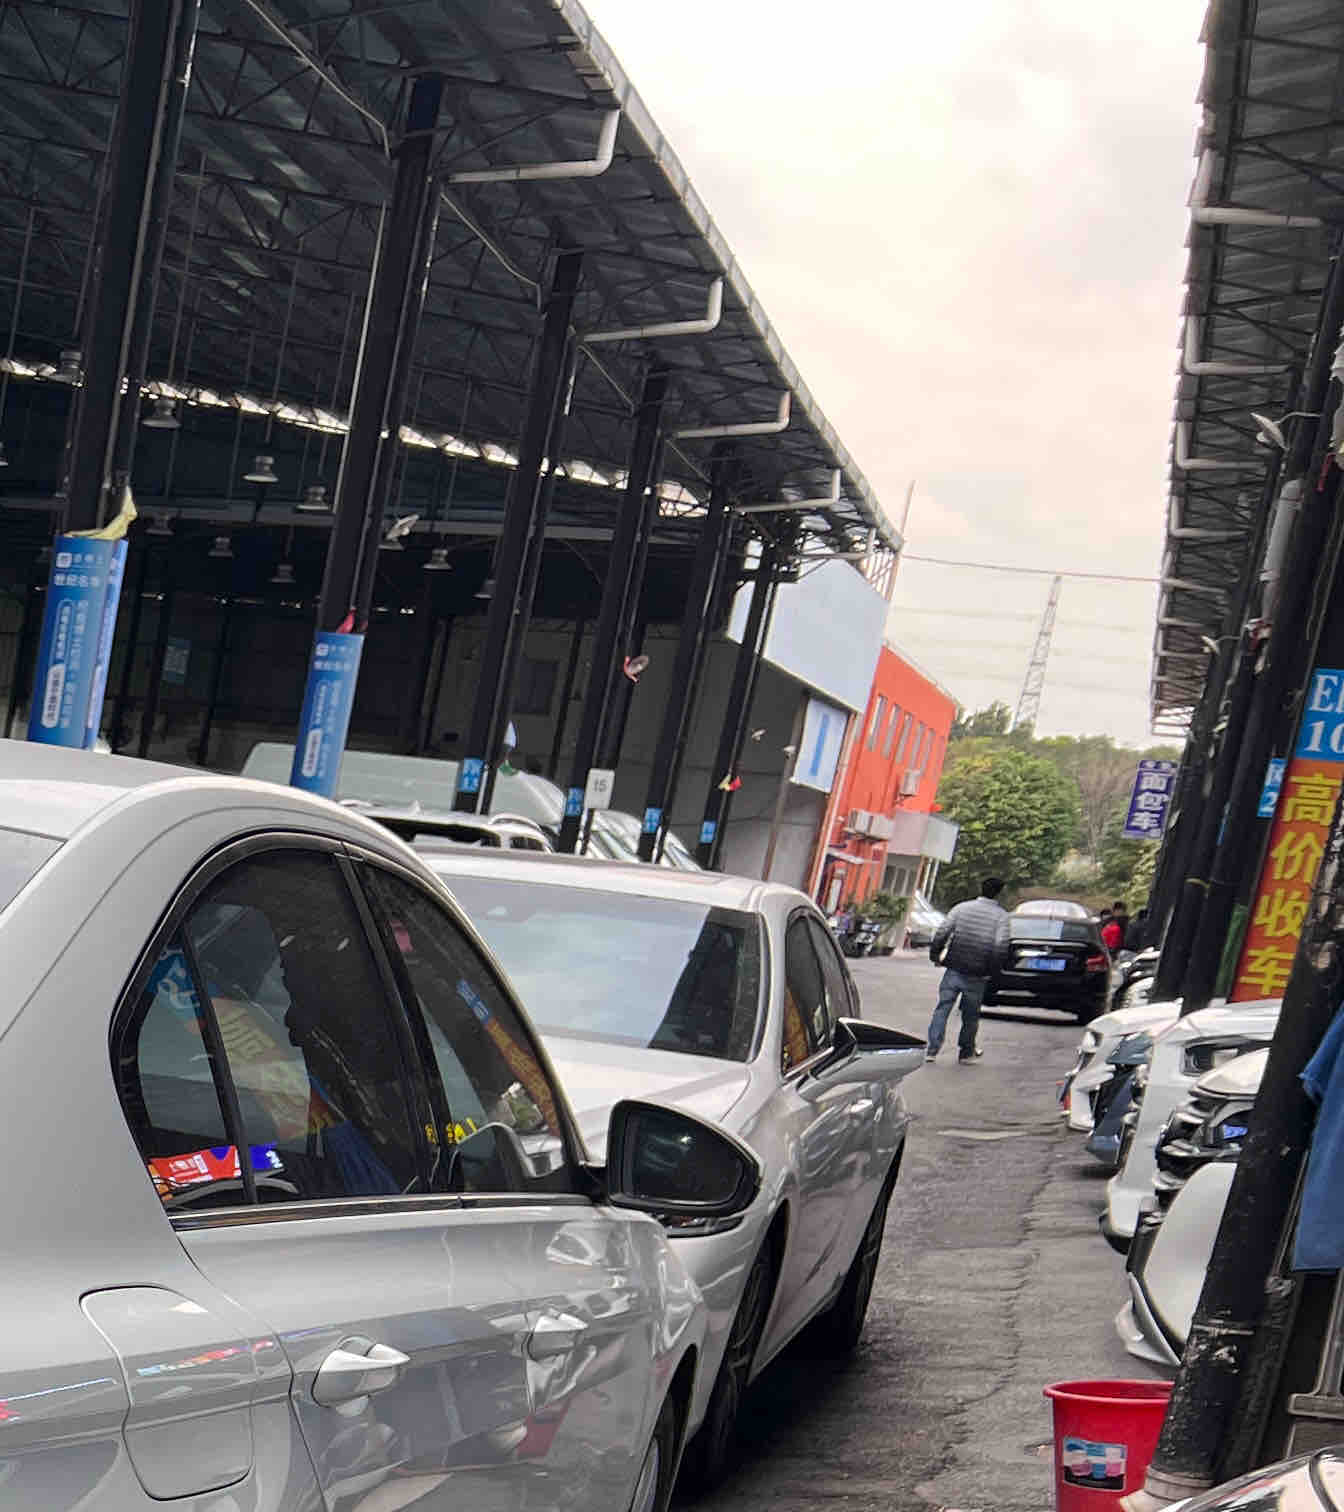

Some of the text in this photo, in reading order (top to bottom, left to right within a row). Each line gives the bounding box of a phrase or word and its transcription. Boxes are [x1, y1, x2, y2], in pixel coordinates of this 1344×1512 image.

[1309, 674, 1344, 714] E
[1240, 771, 1342, 997] 高价收车
